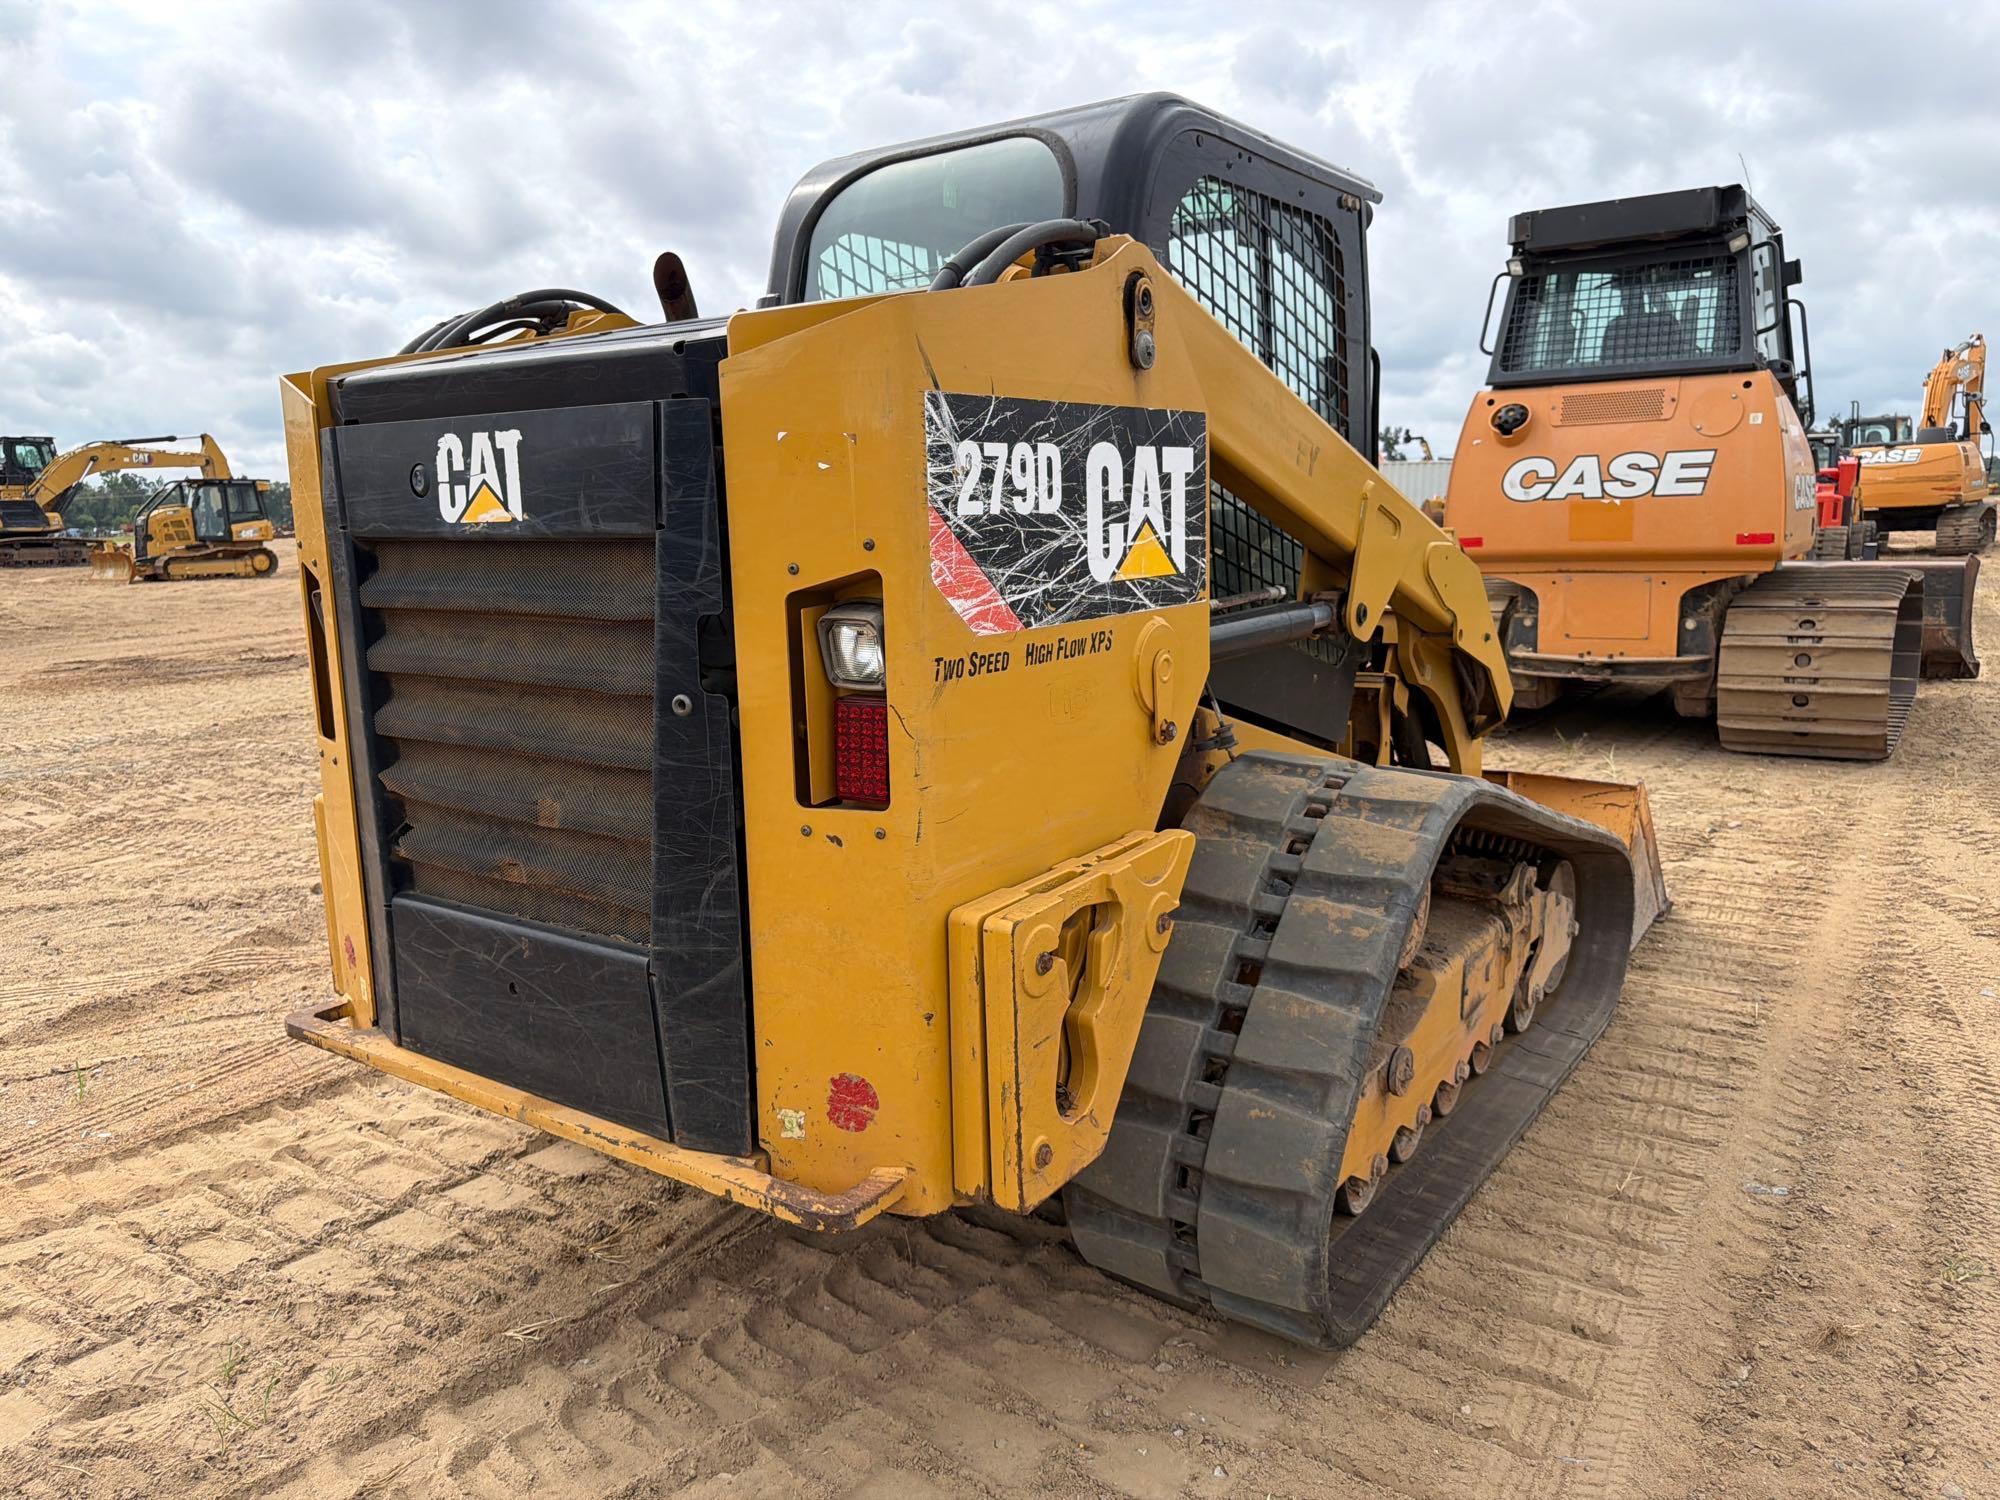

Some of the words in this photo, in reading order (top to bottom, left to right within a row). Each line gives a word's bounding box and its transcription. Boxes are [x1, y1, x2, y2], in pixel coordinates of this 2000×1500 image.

[132, 452, 149, 465] CAT
[436, 429, 524, 525] CAT
[956, 440, 1062, 516] 279D
[1501, 449, 1717, 502] CASE
[1086, 441, 1194, 583] CAT
[1795, 474, 1816, 510] CASE
[1089, 630, 1113, 653] XPS
